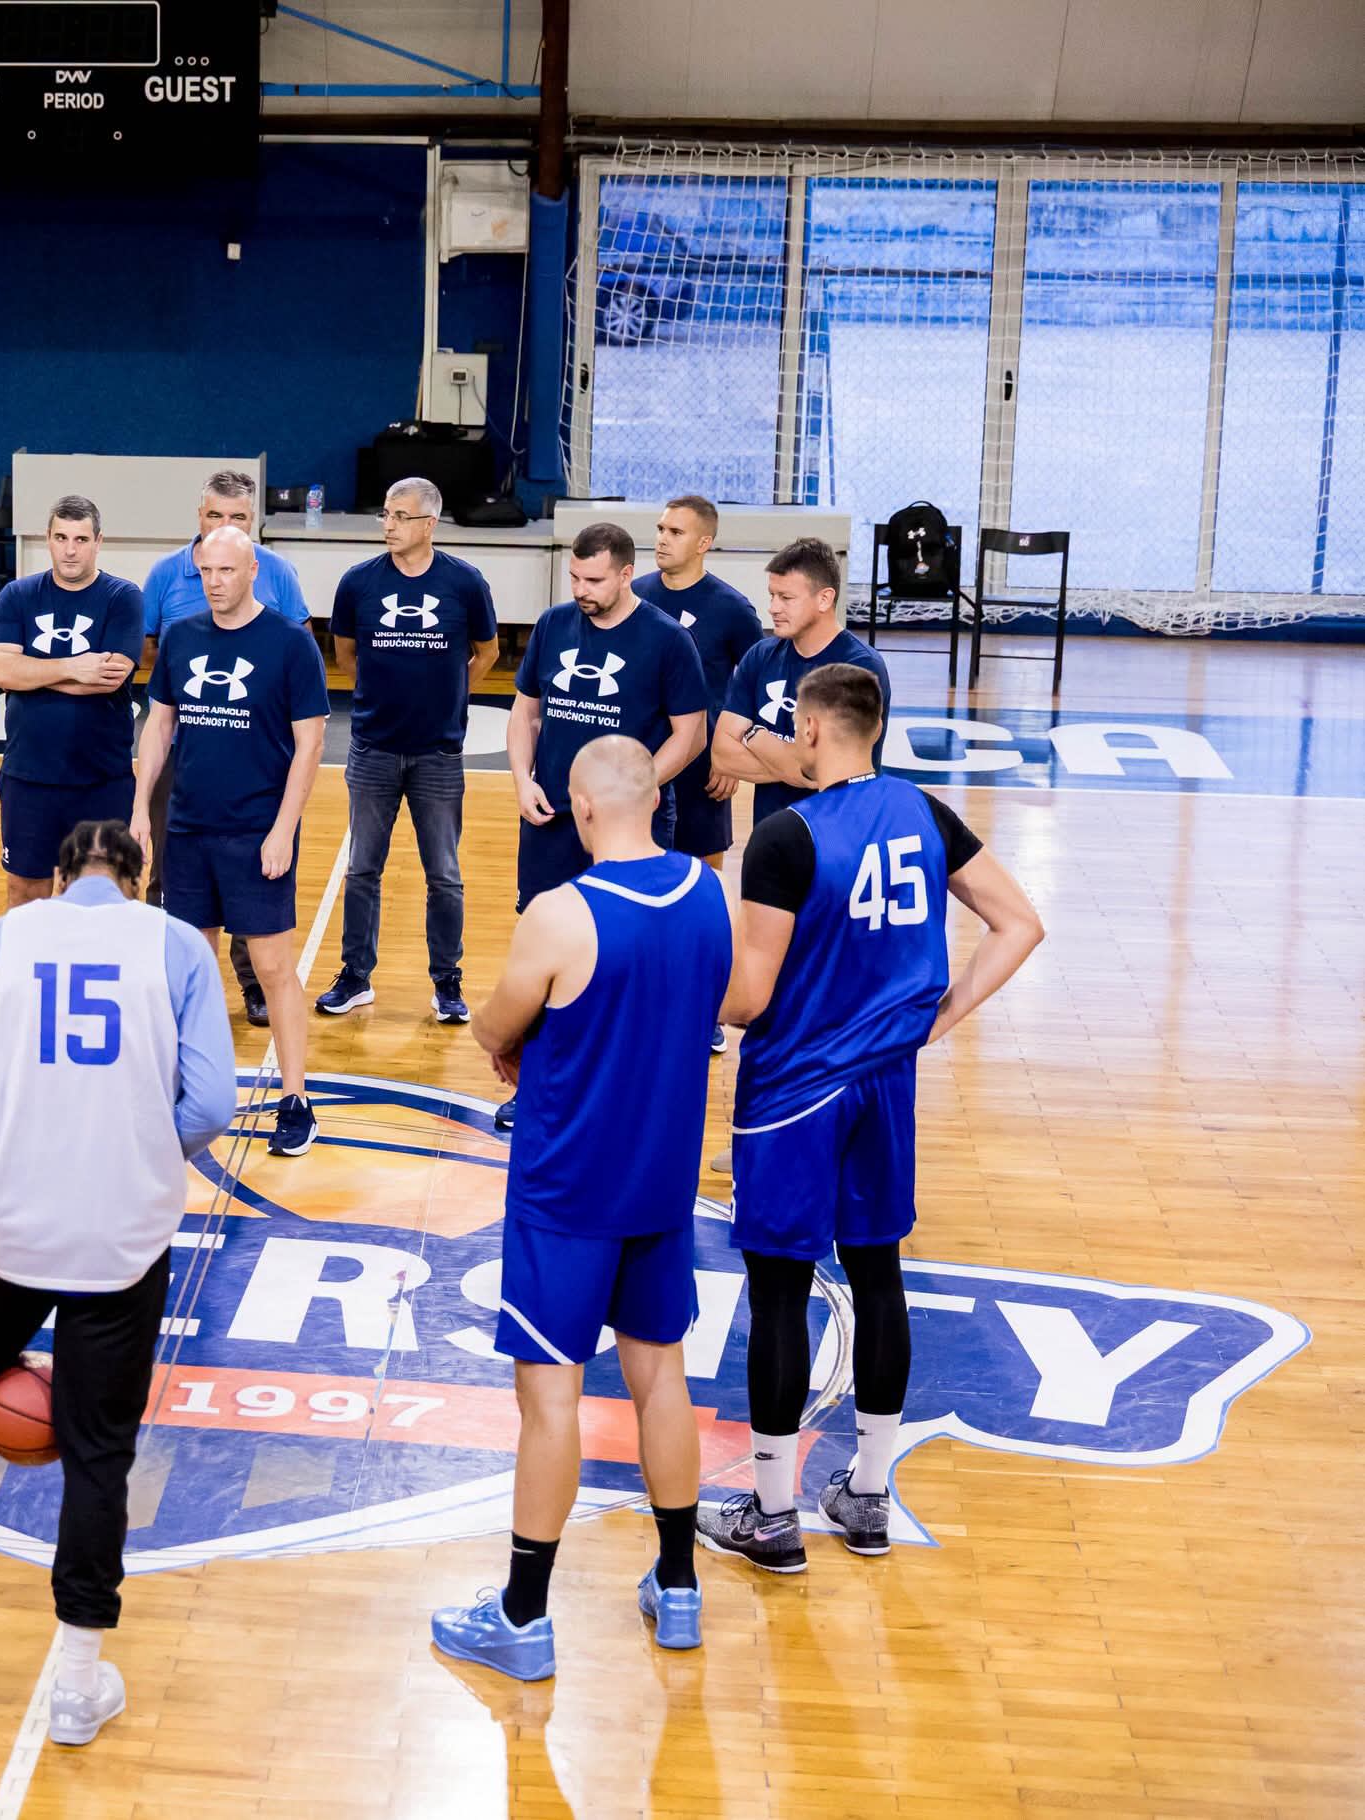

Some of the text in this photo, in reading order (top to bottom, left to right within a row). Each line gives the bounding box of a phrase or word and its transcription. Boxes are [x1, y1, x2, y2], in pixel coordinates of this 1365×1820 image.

[144, 76, 236, 103] GUEST
[44, 92, 104, 109] PERIOD
[372, 638, 448, 649] BUDUĆNOST VOLI
[179, 703, 251, 718] UNDER ARMOUR
[547, 696, 621, 714] UNDER ARMOUR
[179, 714, 250, 729] BUDUĆNOST VOLI
[547, 707, 621, 728] BUDUĆNOST VOLI
[849, 834, 928, 931] 45
[34, 963, 121, 1066] 15
[169, 1381, 446, 1429] 1997
